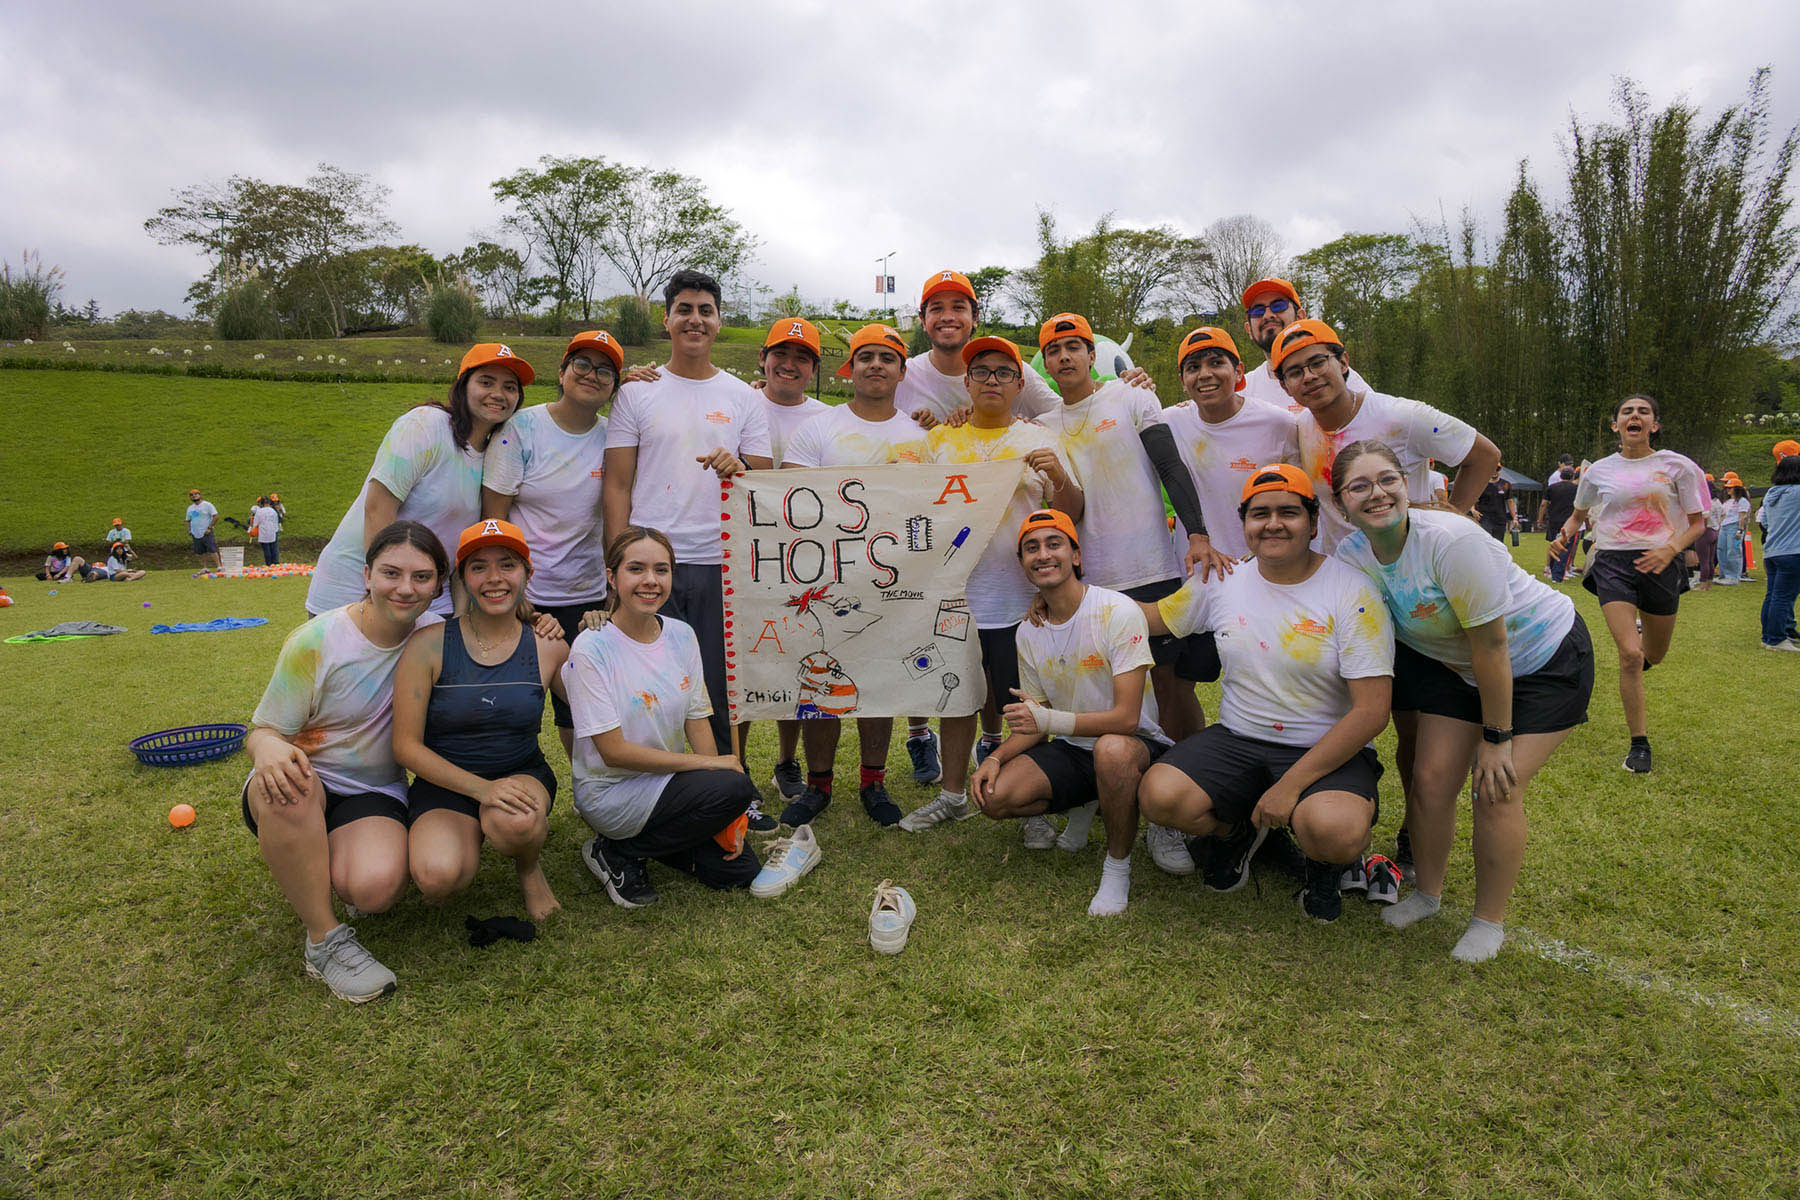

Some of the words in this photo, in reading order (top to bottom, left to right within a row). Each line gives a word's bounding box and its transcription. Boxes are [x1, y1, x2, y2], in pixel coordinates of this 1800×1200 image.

[941, 272, 953, 282] A
[593, 332, 609, 344] A
[788, 323, 804, 338] A
[497, 345, 512, 358] A
[933, 475, 978, 505] A
[748, 479, 870, 533] LOS
[481, 520, 503, 536] A
[751, 531, 899, 588] HOFS
[880, 589, 898, 598] THE
[900, 590, 924, 598] MOVIE
[750, 620, 785, 653] A
